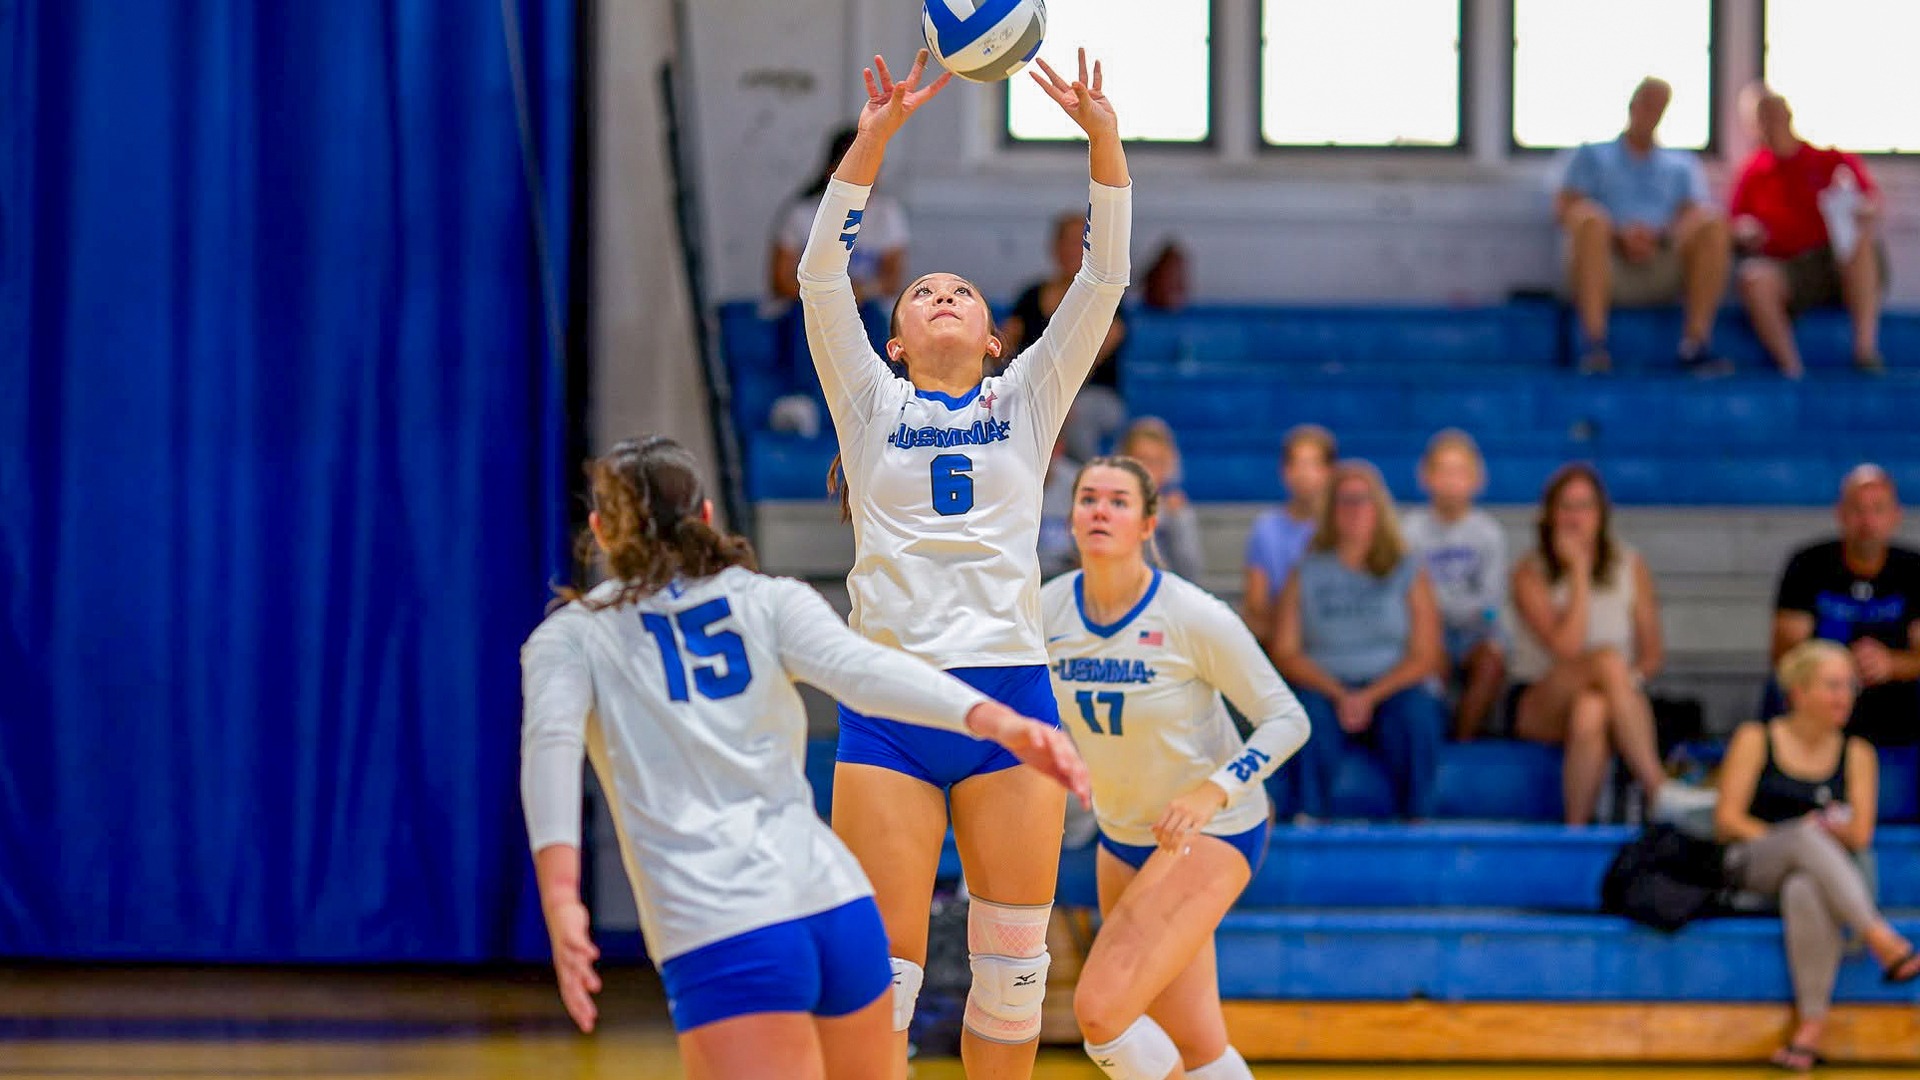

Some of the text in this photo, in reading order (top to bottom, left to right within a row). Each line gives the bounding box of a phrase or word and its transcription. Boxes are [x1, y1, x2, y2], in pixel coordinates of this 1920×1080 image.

[895, 417, 1009, 449] USMMA
[931, 454, 974, 516] 6
[640, 597, 752, 702] 15
[1059, 658, 1150, 683] USMMA
[1075, 690, 1124, 736] 17
